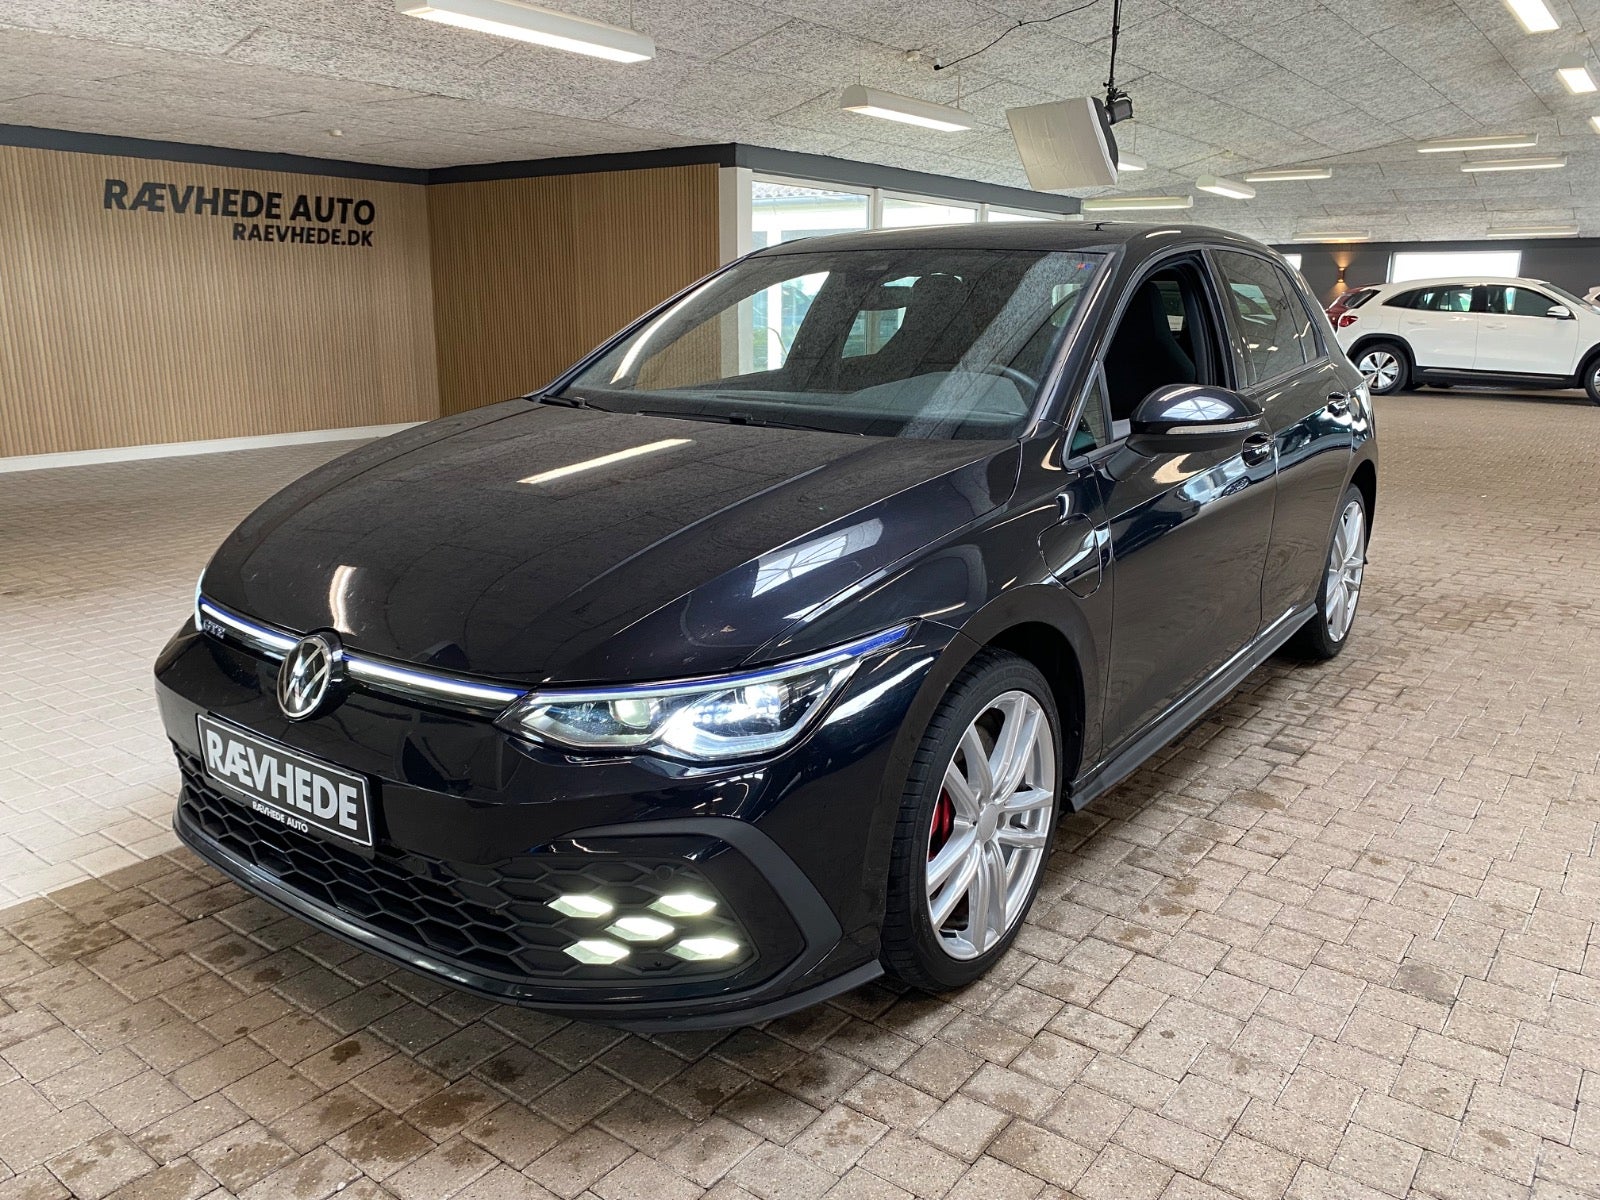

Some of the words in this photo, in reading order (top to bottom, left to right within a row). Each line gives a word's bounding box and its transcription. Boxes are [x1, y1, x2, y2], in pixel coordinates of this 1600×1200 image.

[103, 178, 283, 220] RÆVHEDE
[289, 194, 376, 226] AUTO
[232, 222, 374, 248] RAEVHEDE.DK
[203, 619, 226, 640] GTE
[206, 728, 358, 831] RÆVHEDE
[252, 800, 286, 824] RÆVHEDE
[286, 816, 309, 833] AUTO
